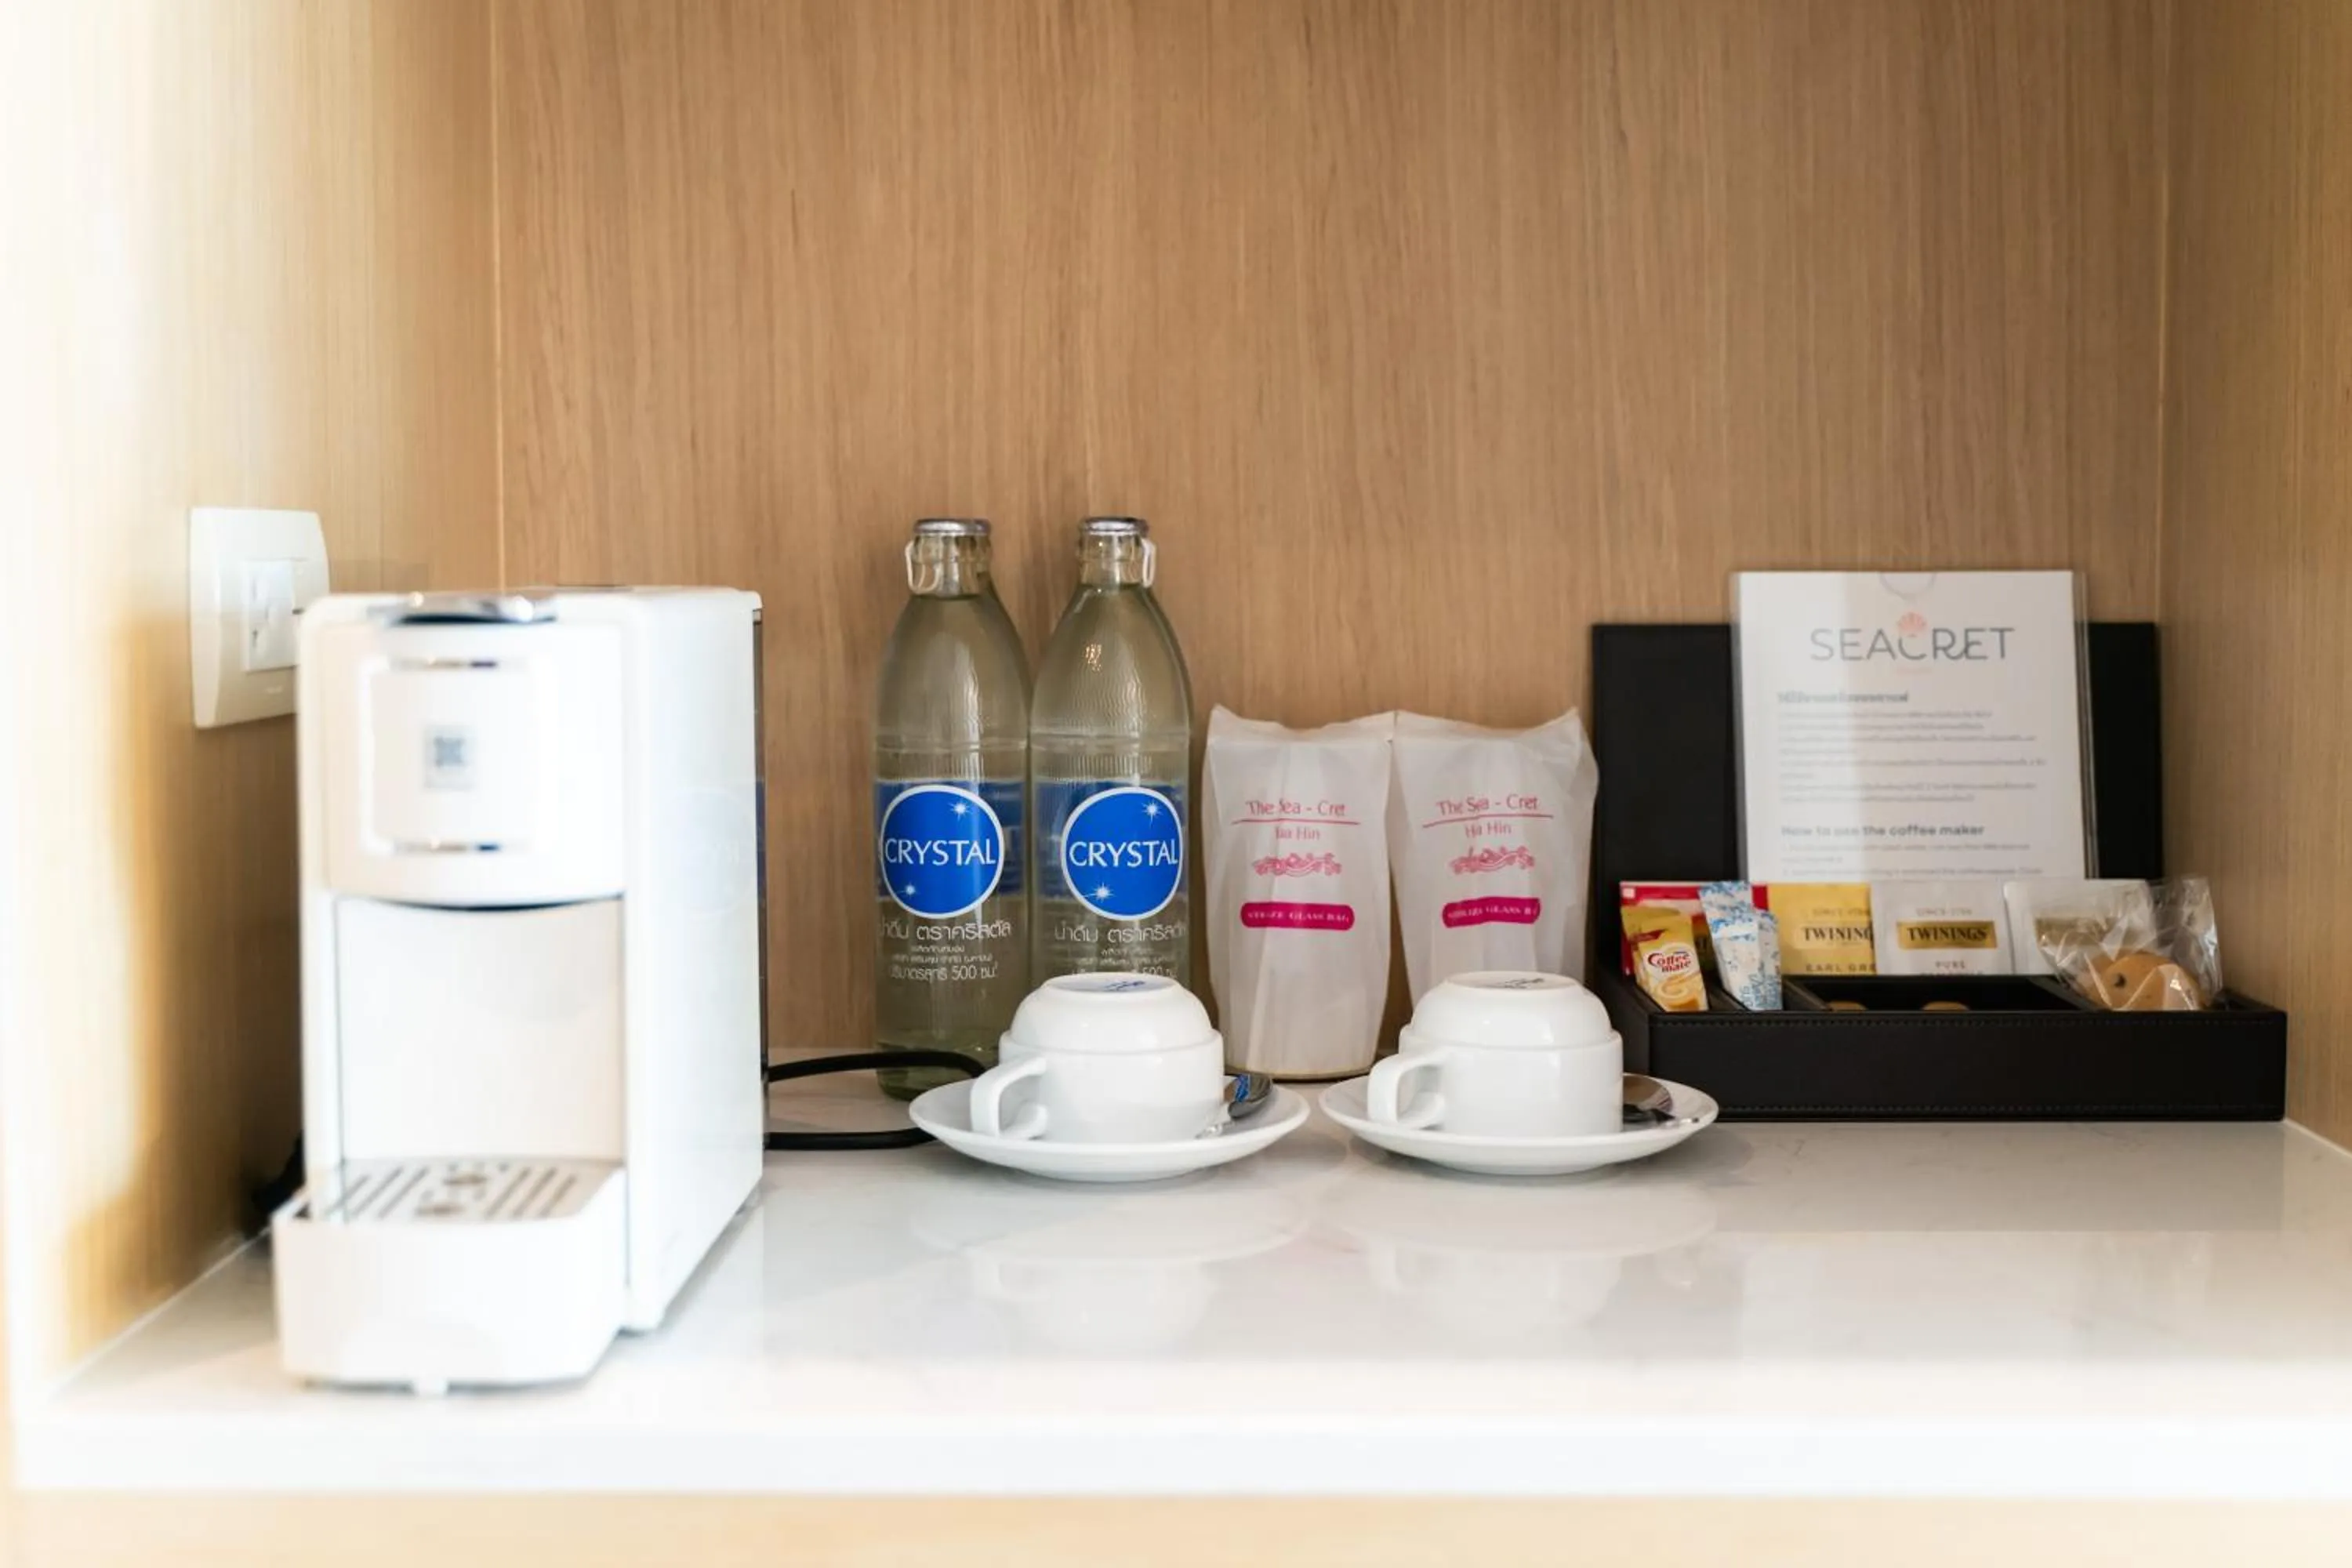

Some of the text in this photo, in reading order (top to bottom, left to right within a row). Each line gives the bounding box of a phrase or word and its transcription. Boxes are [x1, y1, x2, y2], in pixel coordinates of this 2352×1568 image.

[1809, 626, 2016, 661] SEACRET
[1245, 800, 1275, 816] The
[1318, 800, 1346, 817] Cret
[1436, 800, 1463, 815] The
[1506, 793, 1538, 809] Cret
[1861, 825, 1886, 837] the
[1889, 824, 1937, 837] coffee
[1939, 824, 1986, 837] maker
[884, 839, 997, 866] CRYSTAL
[1069, 841, 1178, 867] CRYSTAL
[1802, 927, 1872, 942] TWINING
[1907, 927, 1987, 942] TWININGS
[1648, 952, 1691, 967] Coffee
[952, 964, 977, 980] 500
